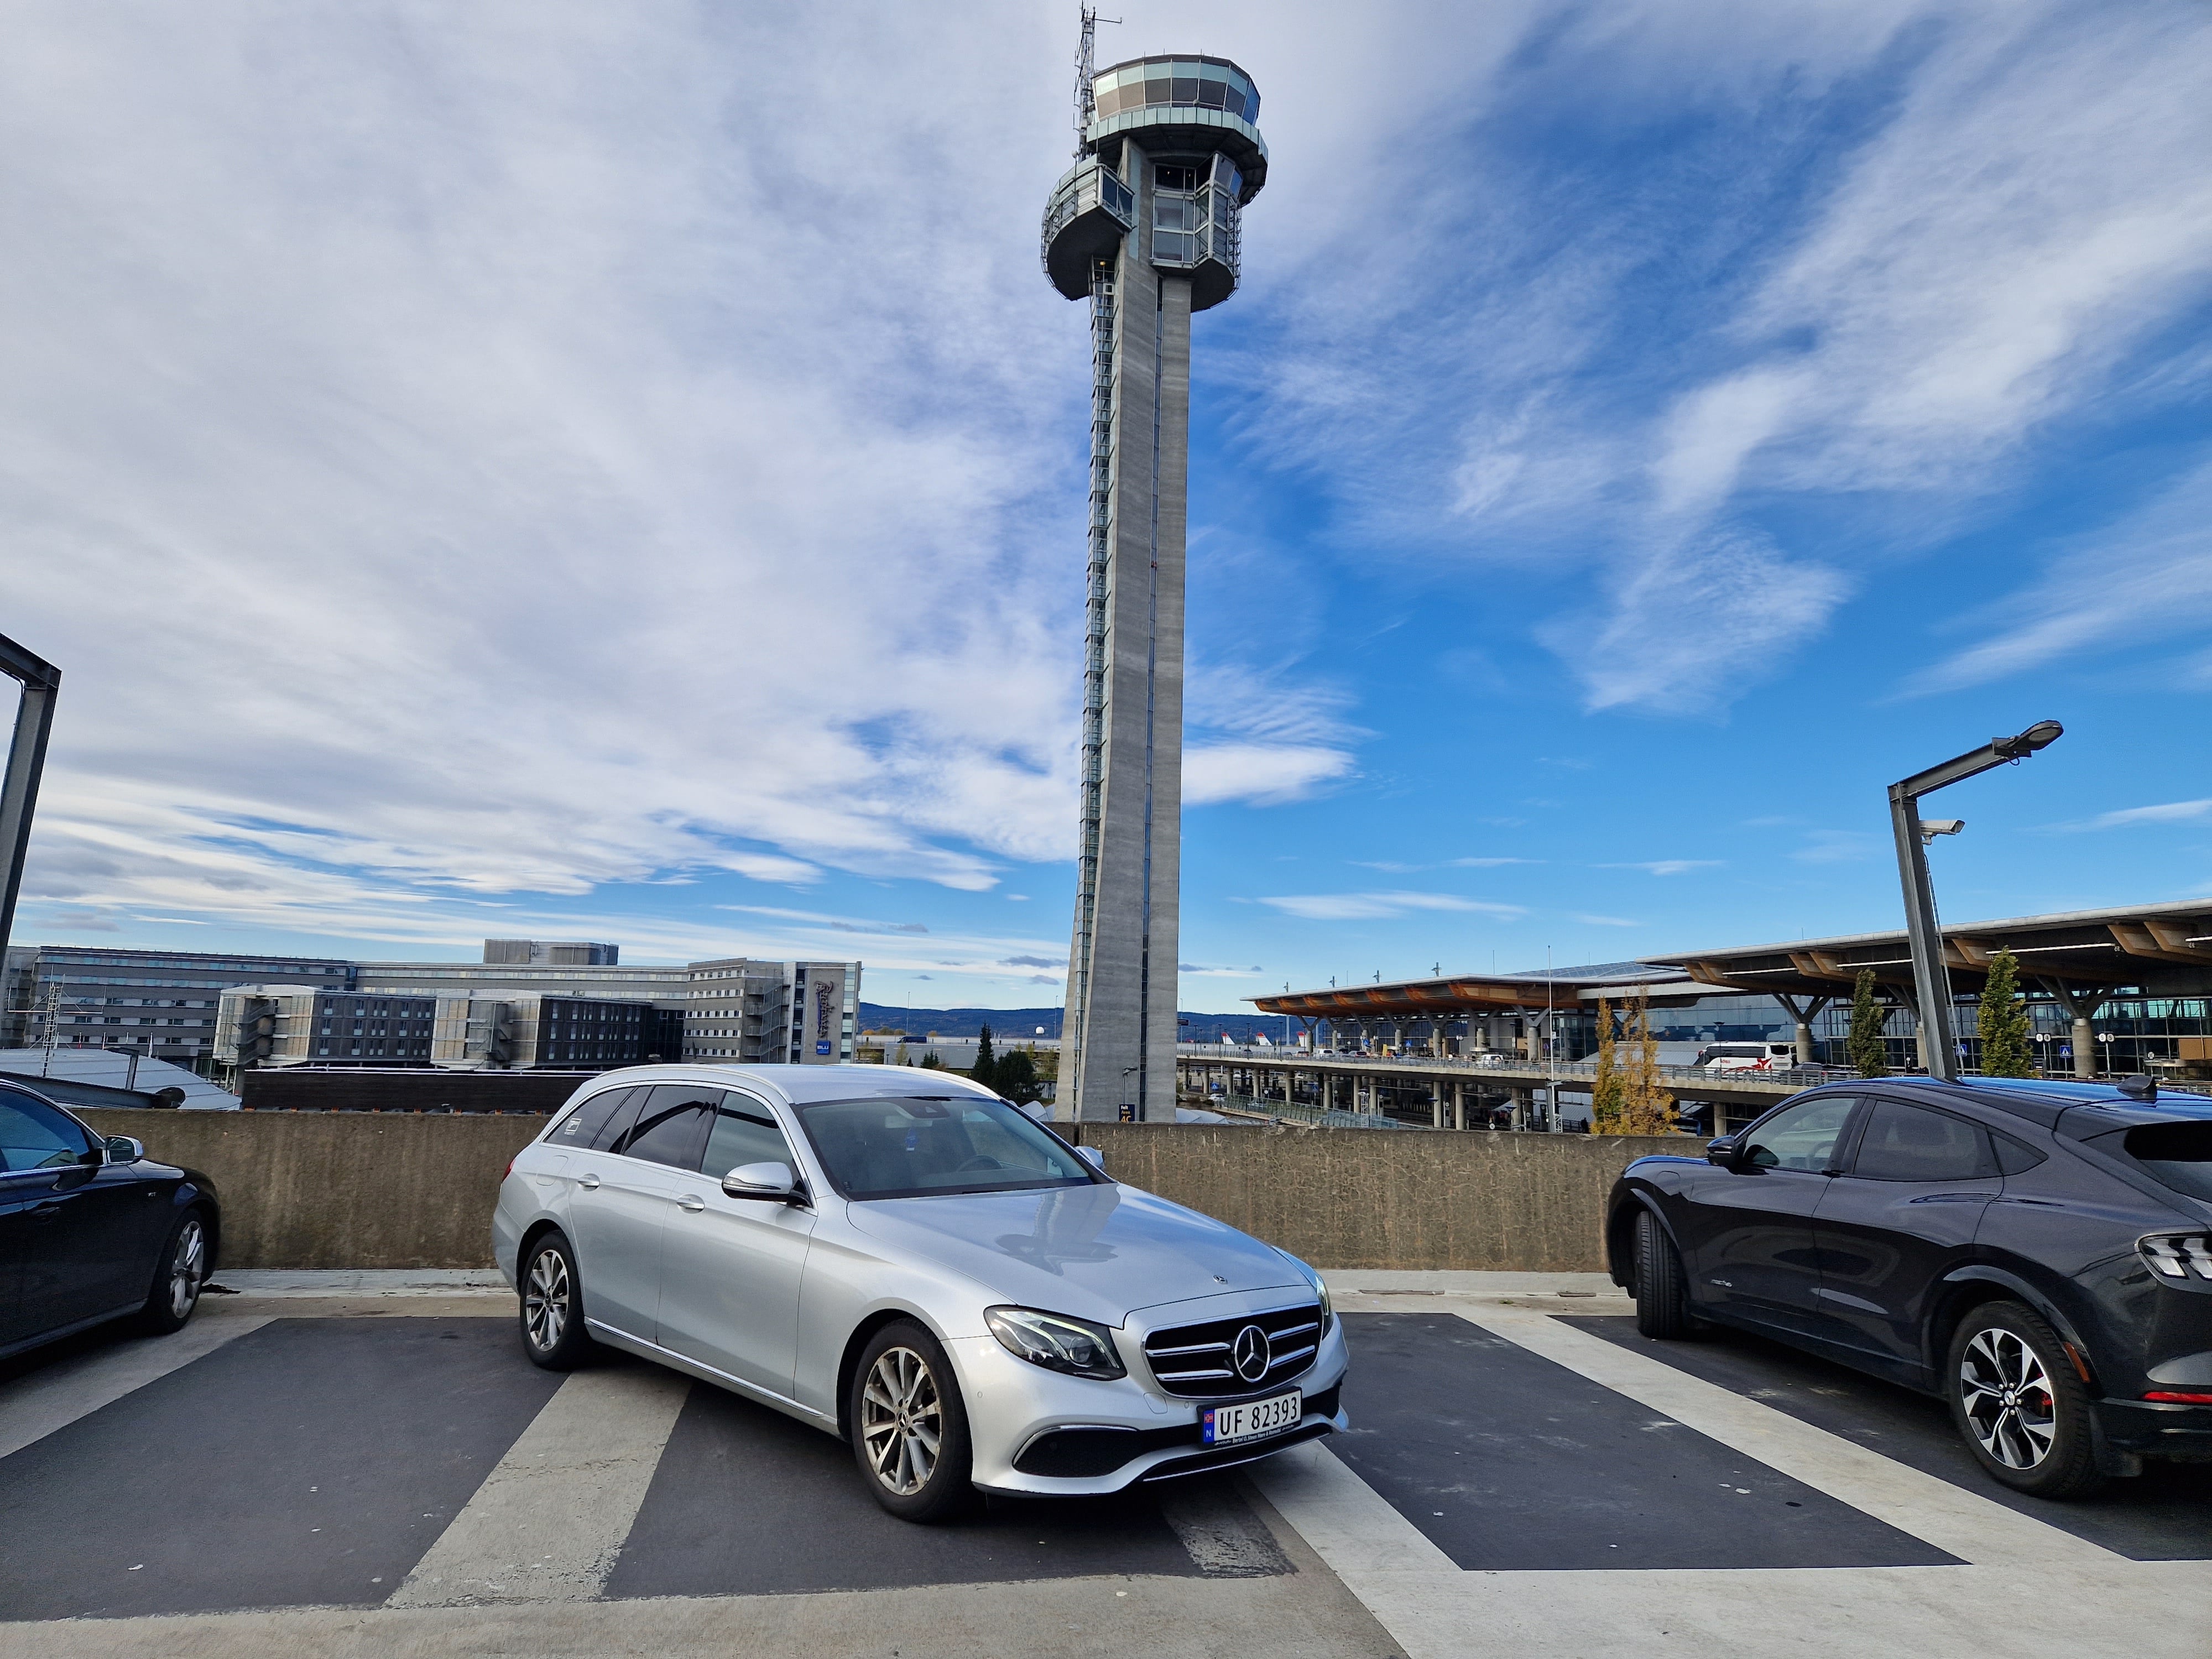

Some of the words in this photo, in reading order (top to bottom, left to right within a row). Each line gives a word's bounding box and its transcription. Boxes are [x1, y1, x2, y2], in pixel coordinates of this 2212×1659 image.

[1220, 1410, 1243, 1436] UF
[1251, 1396, 1297, 1430] 82393
[1206, 1430, 1212, 1438] N
